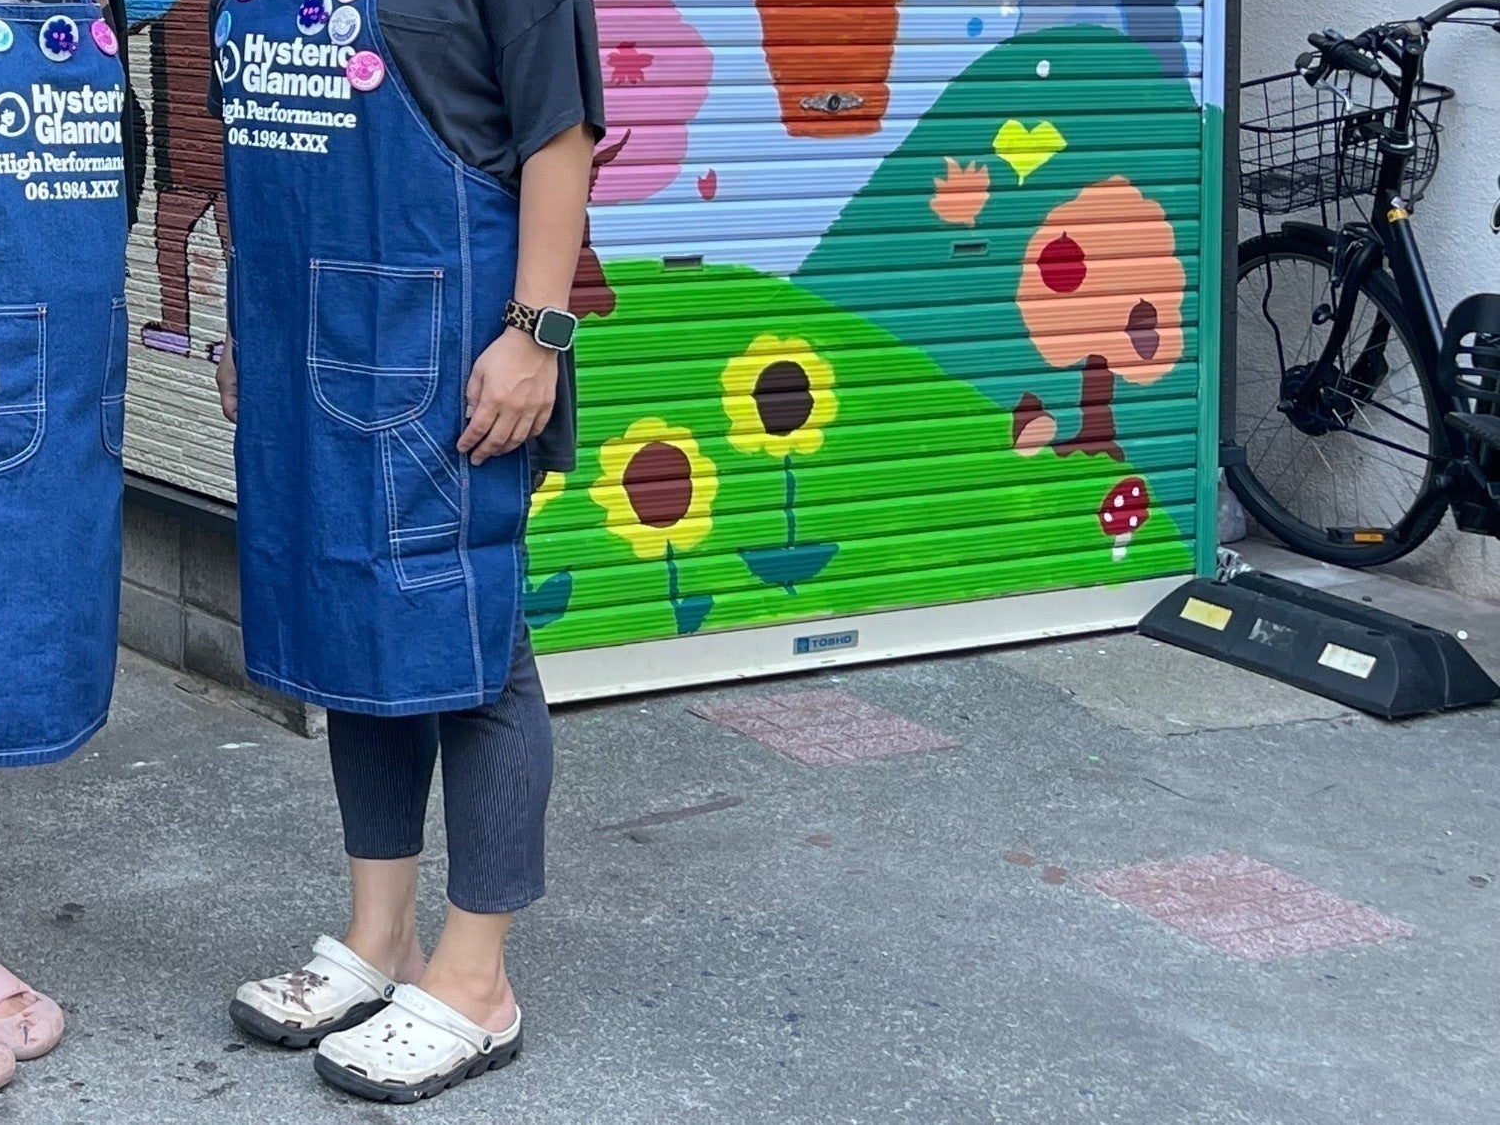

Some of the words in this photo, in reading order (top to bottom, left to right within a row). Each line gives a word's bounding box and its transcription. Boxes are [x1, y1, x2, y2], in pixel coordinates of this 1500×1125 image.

[244, 33, 356, 70] Hysteric
[246, 99, 357, 129] Performance
[228, 127, 329, 154] 06.1984.XXX
[24, 179, 119, 201] 06.1984.XXX
